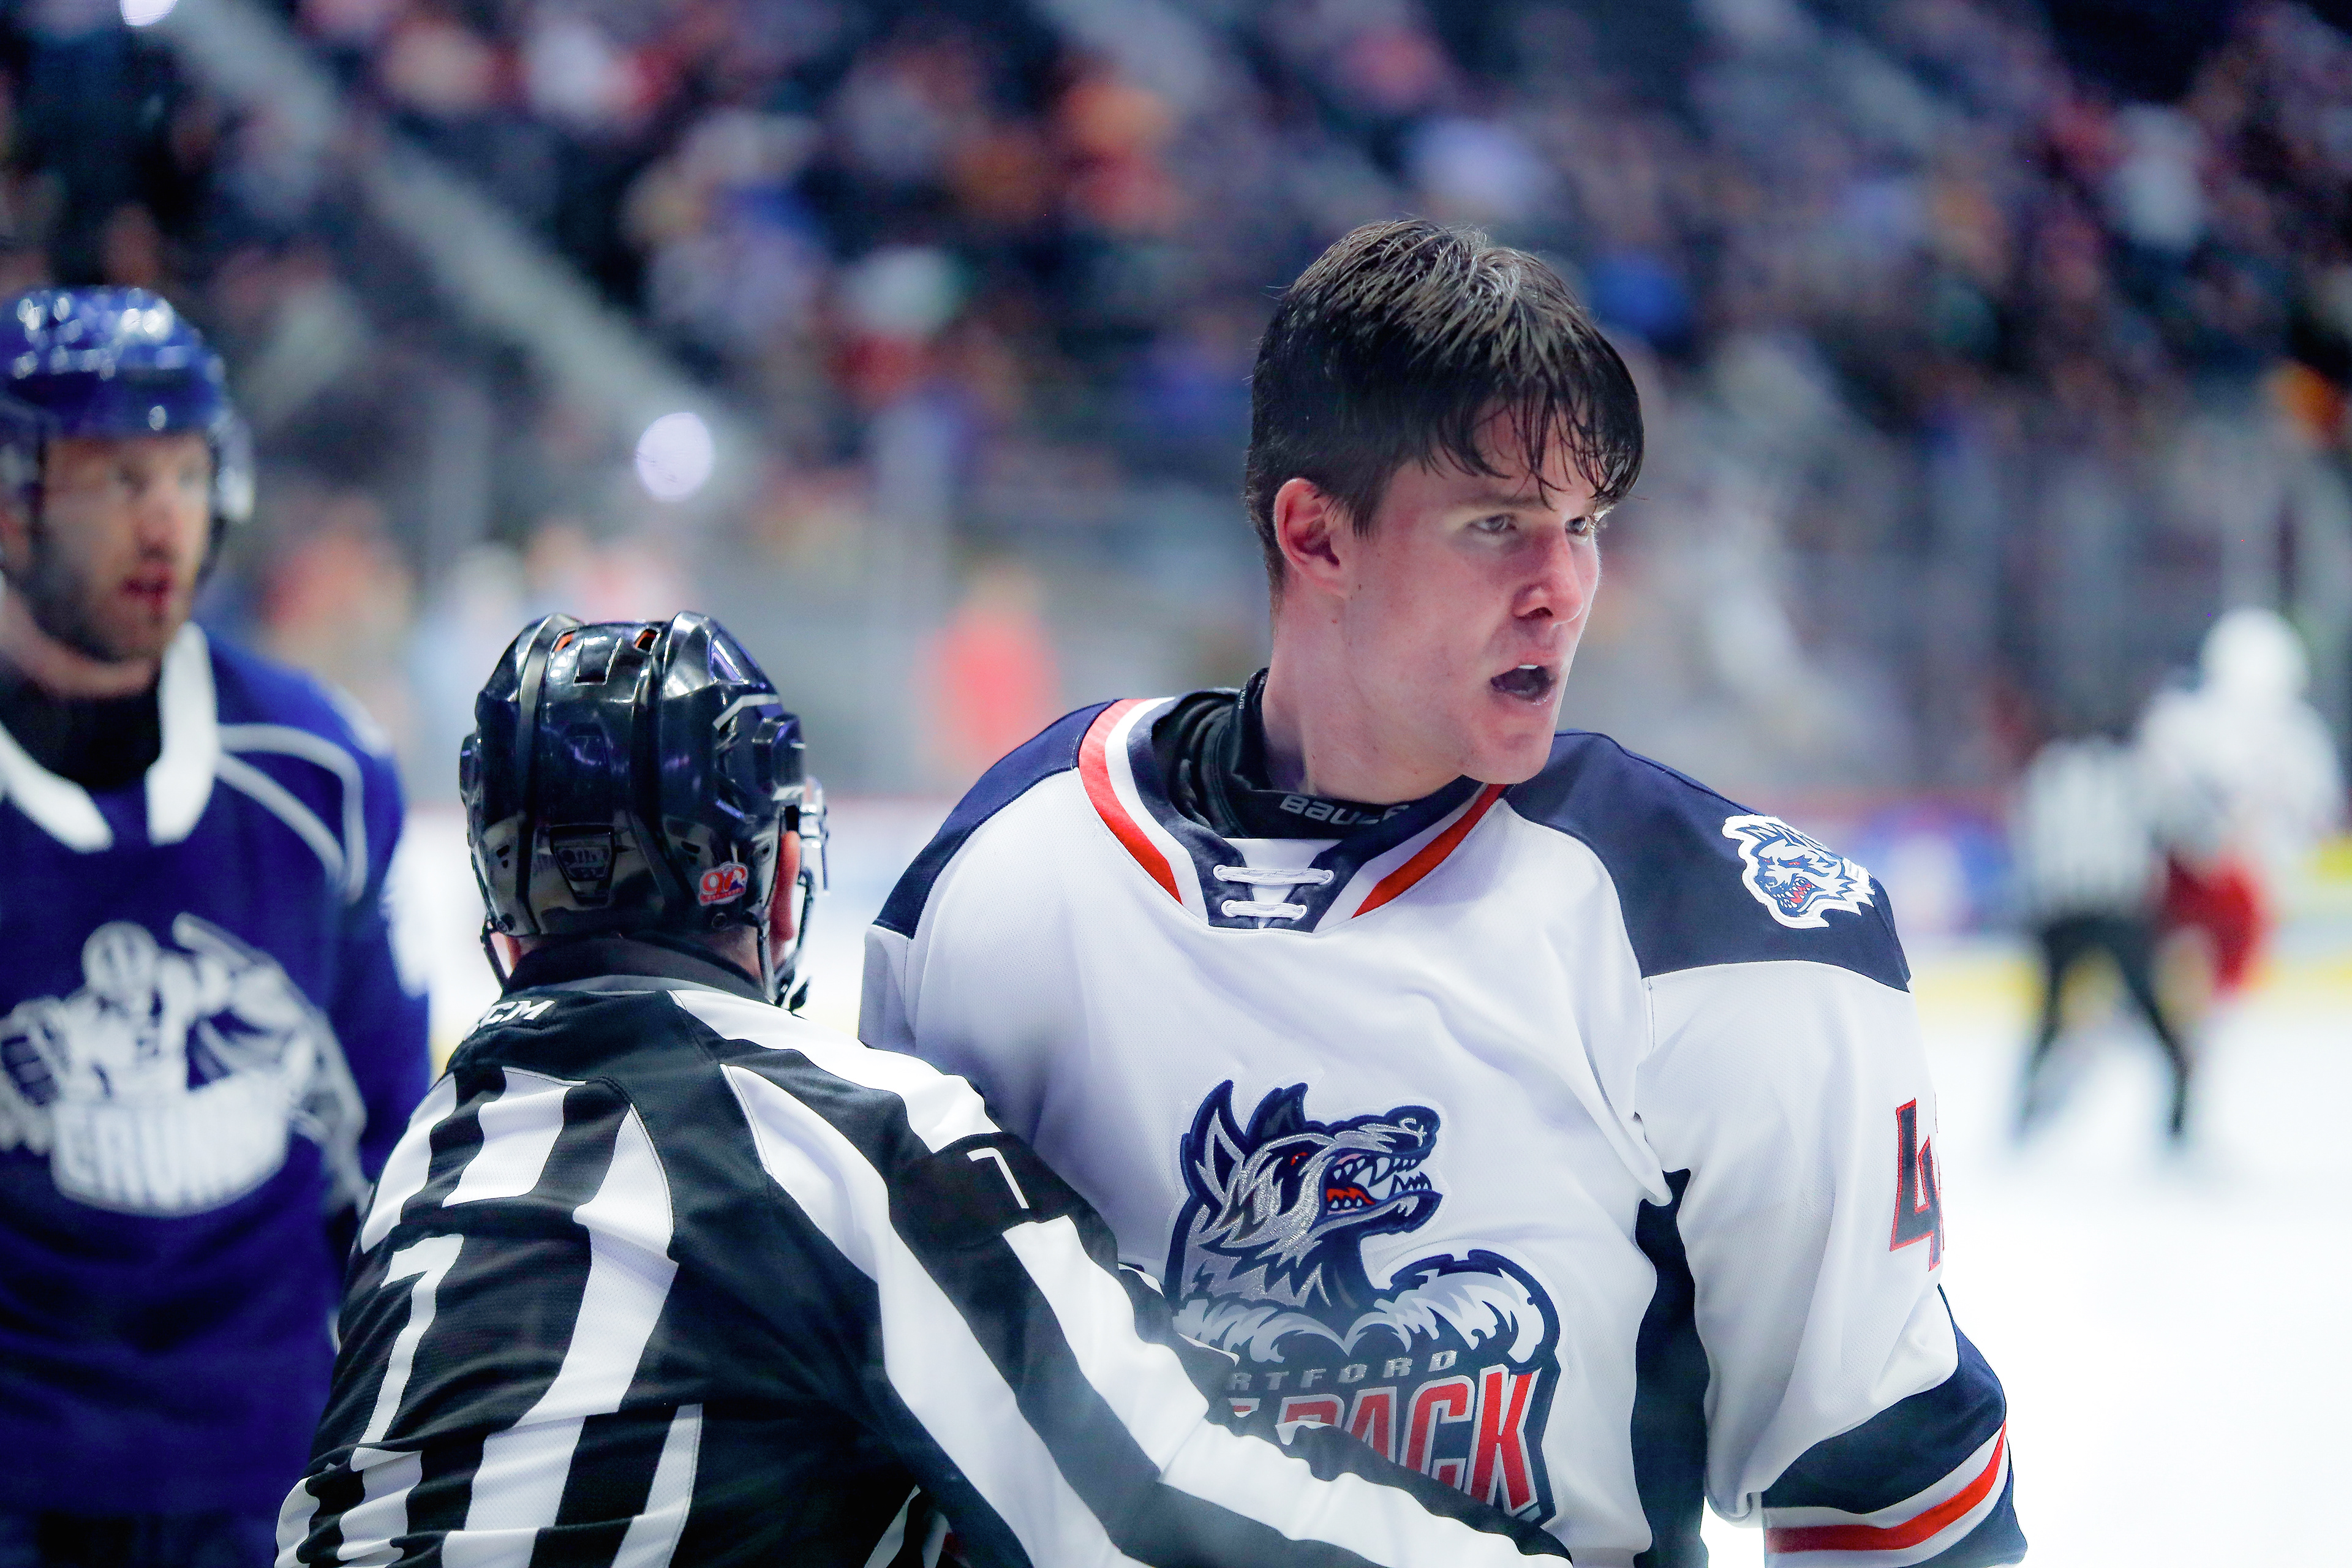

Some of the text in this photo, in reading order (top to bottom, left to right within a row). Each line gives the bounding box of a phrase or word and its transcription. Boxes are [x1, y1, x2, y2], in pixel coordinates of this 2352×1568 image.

[966, 1147, 1030, 1209] 7
[1889, 1090, 1945, 1272] 4
[1227, 1349, 1458, 1391] RTFORD
[1275, 1364, 1542, 1517] ACK
